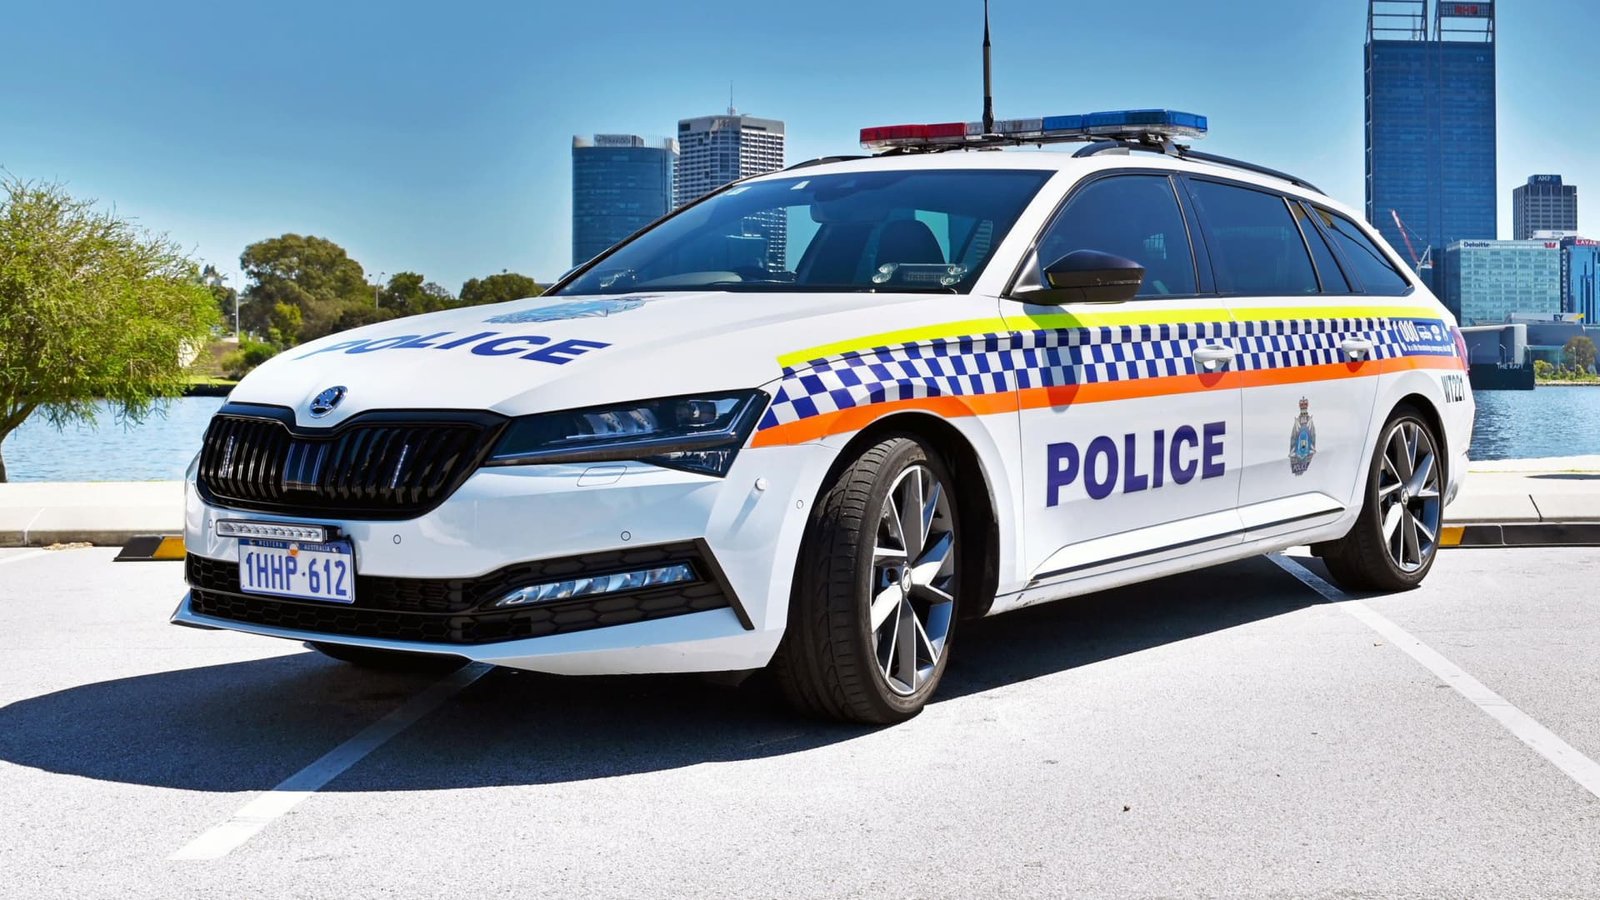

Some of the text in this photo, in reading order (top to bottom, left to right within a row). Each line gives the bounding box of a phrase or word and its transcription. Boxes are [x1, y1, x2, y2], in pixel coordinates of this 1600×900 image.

[291, 331, 613, 366] POLICE
[1046, 420, 1226, 508] POLICE
[258, 540, 331, 552] WESTERN AUSTRALIA
